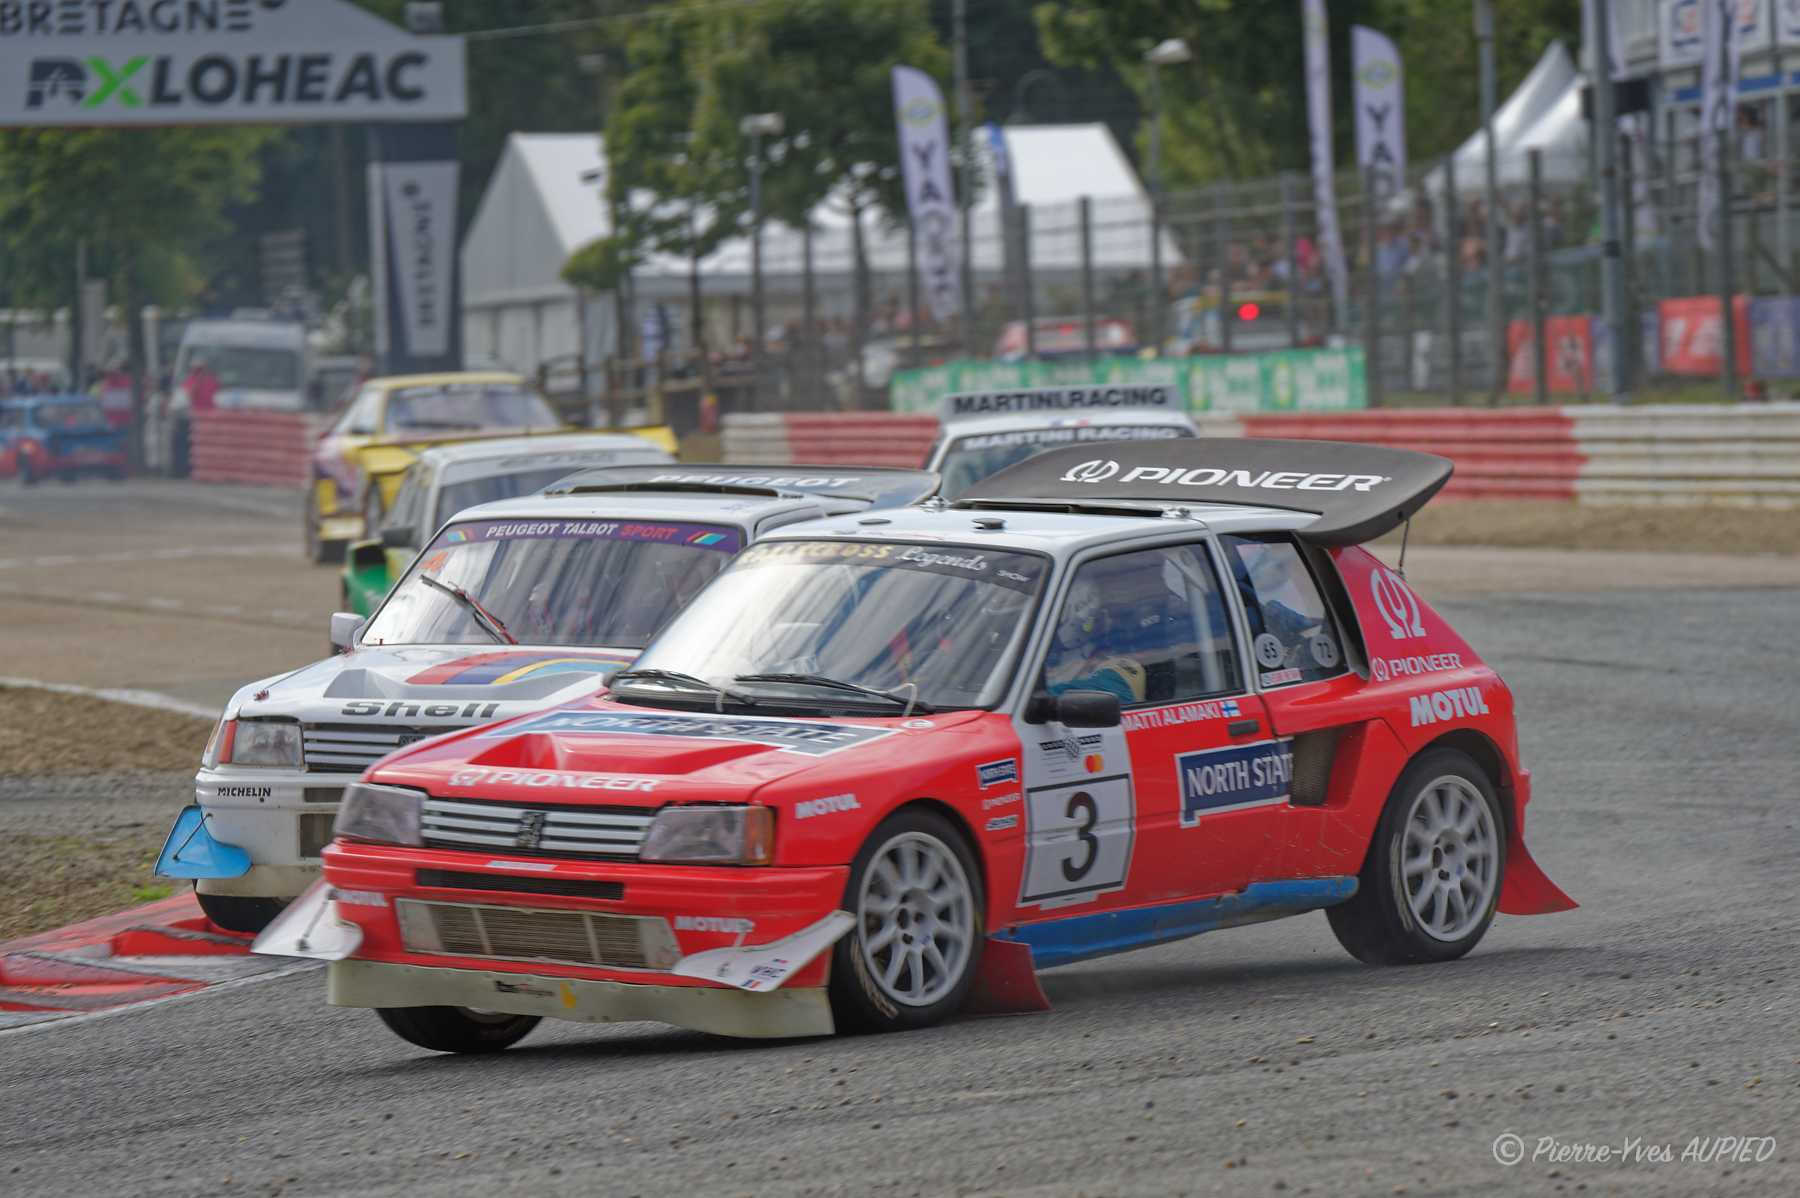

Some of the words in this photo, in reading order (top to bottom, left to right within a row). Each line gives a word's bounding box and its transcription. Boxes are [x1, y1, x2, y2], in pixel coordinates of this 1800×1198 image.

[0, 0, 252, 34] BRETAGNE
[648, 474, 861, 487] PEUGEOT
[1119, 466, 1388, 492] PIONEER
[486, 523, 559, 537] PEUGEOT
[562, 523, 619, 536] TALBOT
[621, 526, 679, 541] SPORT
[1389, 653, 1462, 677] PIONEER
[341, 701, 500, 718] Shell
[1408, 687, 1489, 727] MOTUL
[487, 770, 662, 792] PIONEER
[1187, 760, 1250, 798] NORTH
[217, 786, 272, 798] MICHELIN
[794, 793, 861, 819] MOTUL
[1061, 791, 1098, 882] 3
